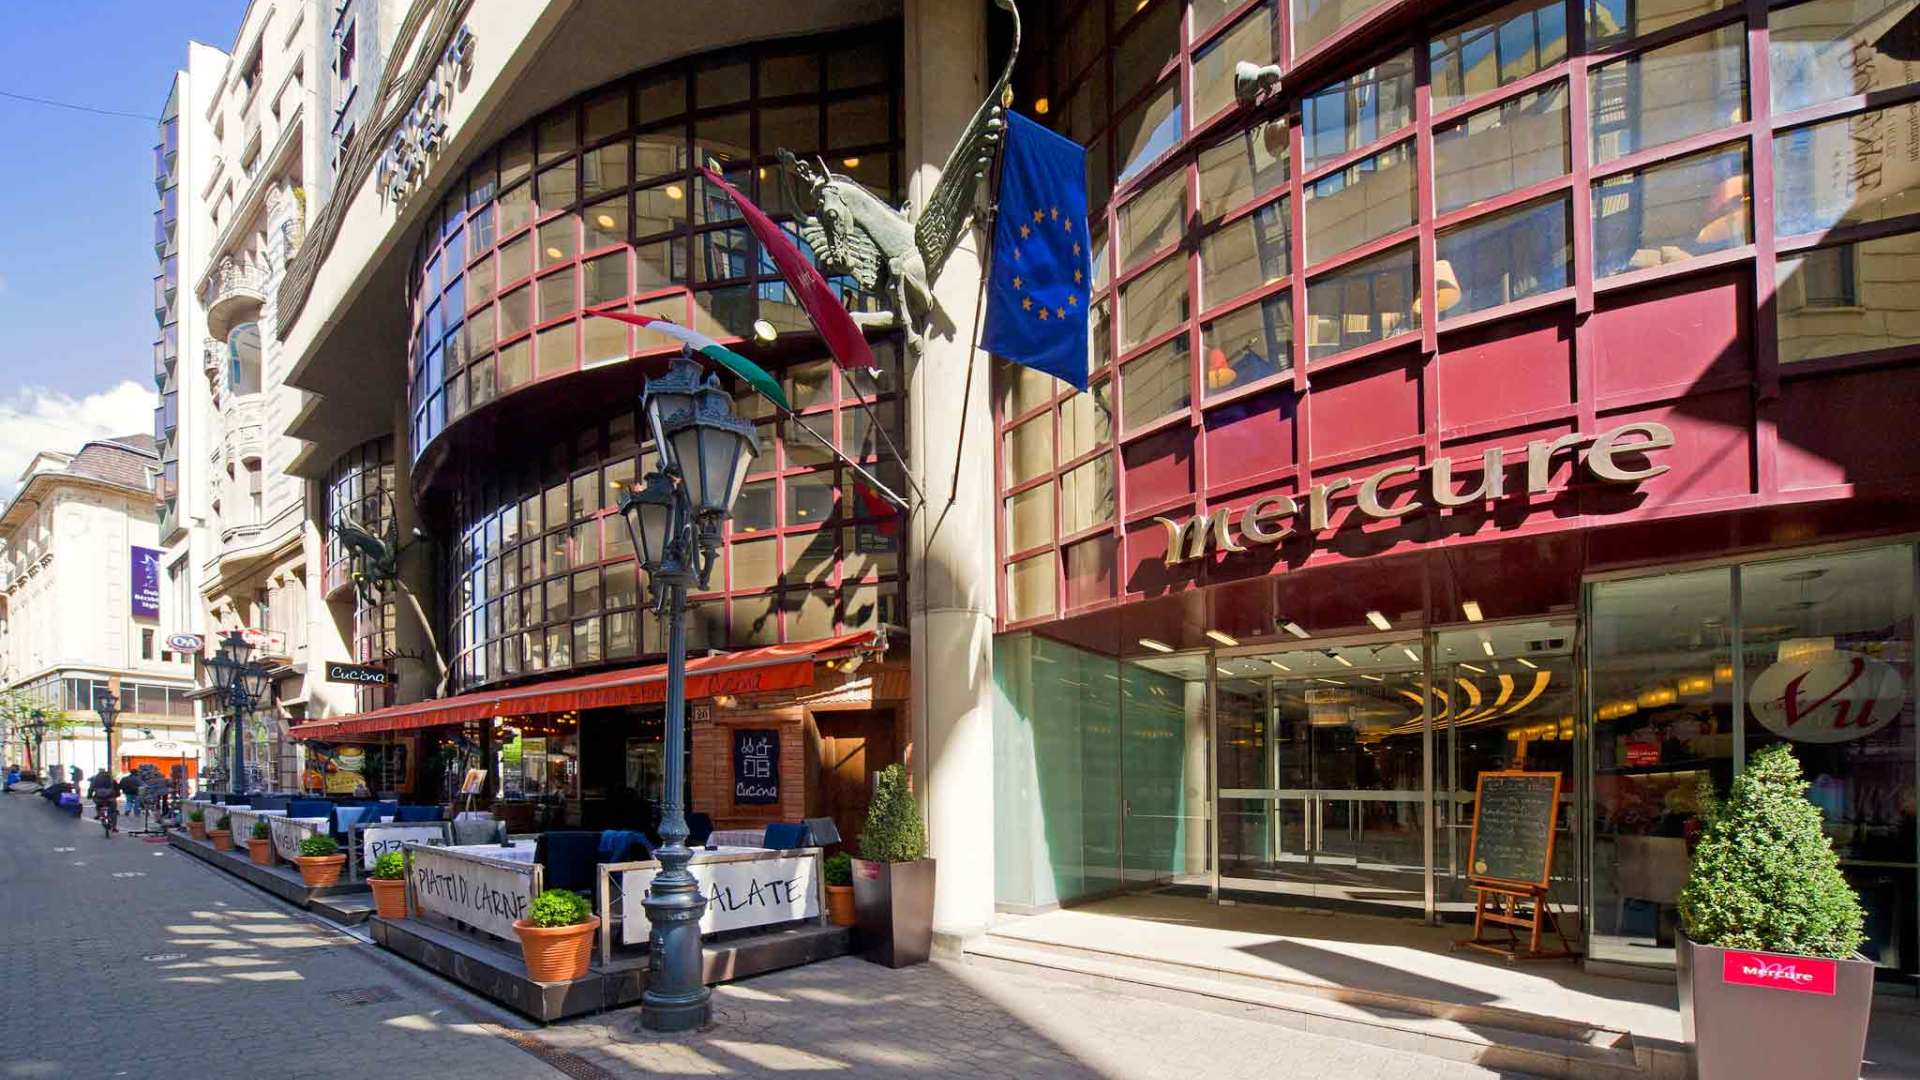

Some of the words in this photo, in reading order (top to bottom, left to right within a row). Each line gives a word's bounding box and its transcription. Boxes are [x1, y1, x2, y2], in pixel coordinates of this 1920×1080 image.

[1153, 421, 1675, 567] mercure
[331, 666, 385, 684] Cucina
[736, 782, 777, 798] Cucina
[1742, 966, 1814, 981] Mercure
